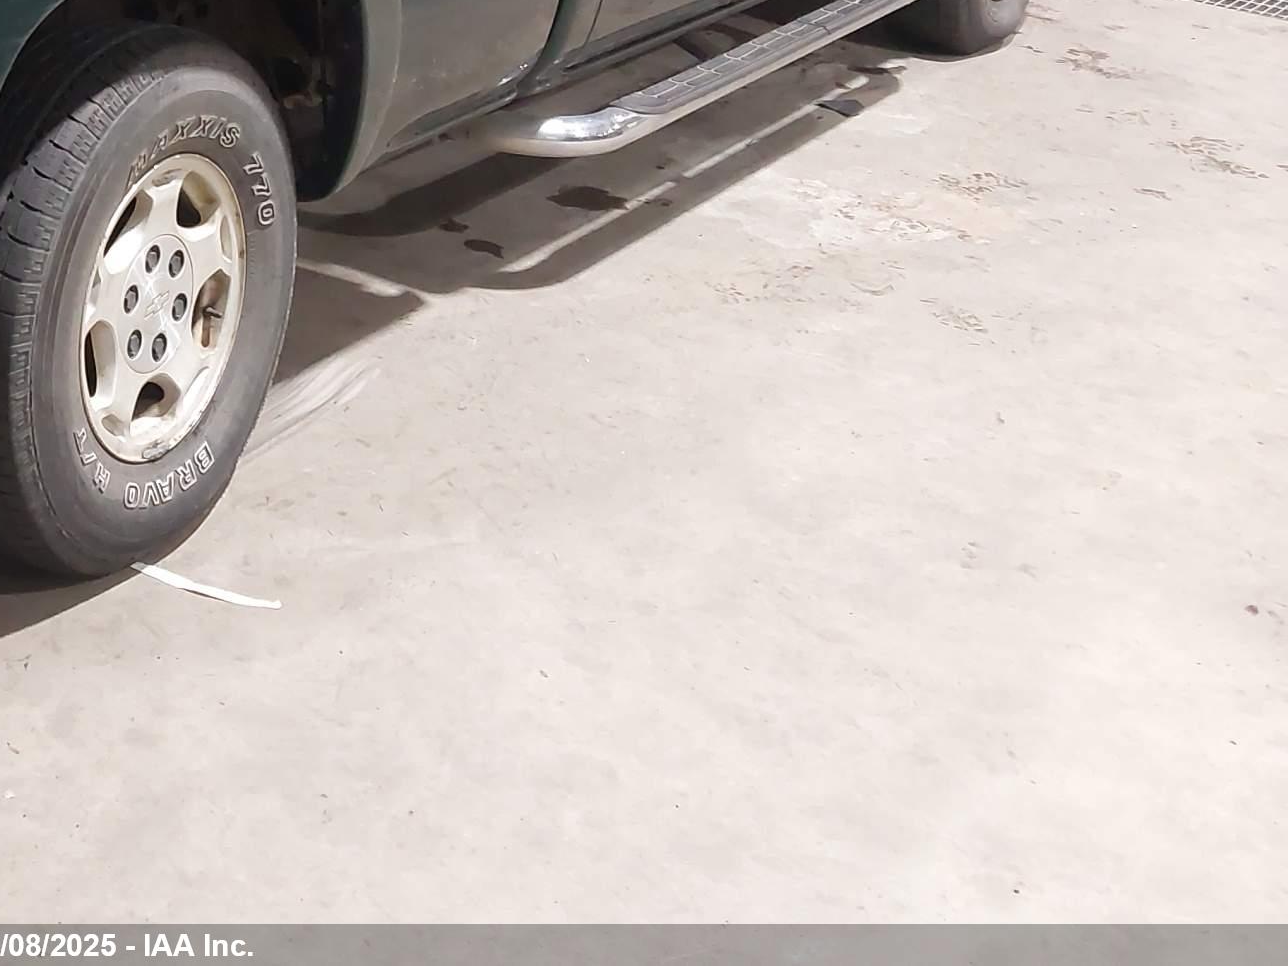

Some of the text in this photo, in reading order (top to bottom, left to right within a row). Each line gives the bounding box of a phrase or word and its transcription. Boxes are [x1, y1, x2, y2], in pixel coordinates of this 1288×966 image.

[126, 114, 275, 225] MAXXIS 770
[124, 440, 215, 509] BRAVO
